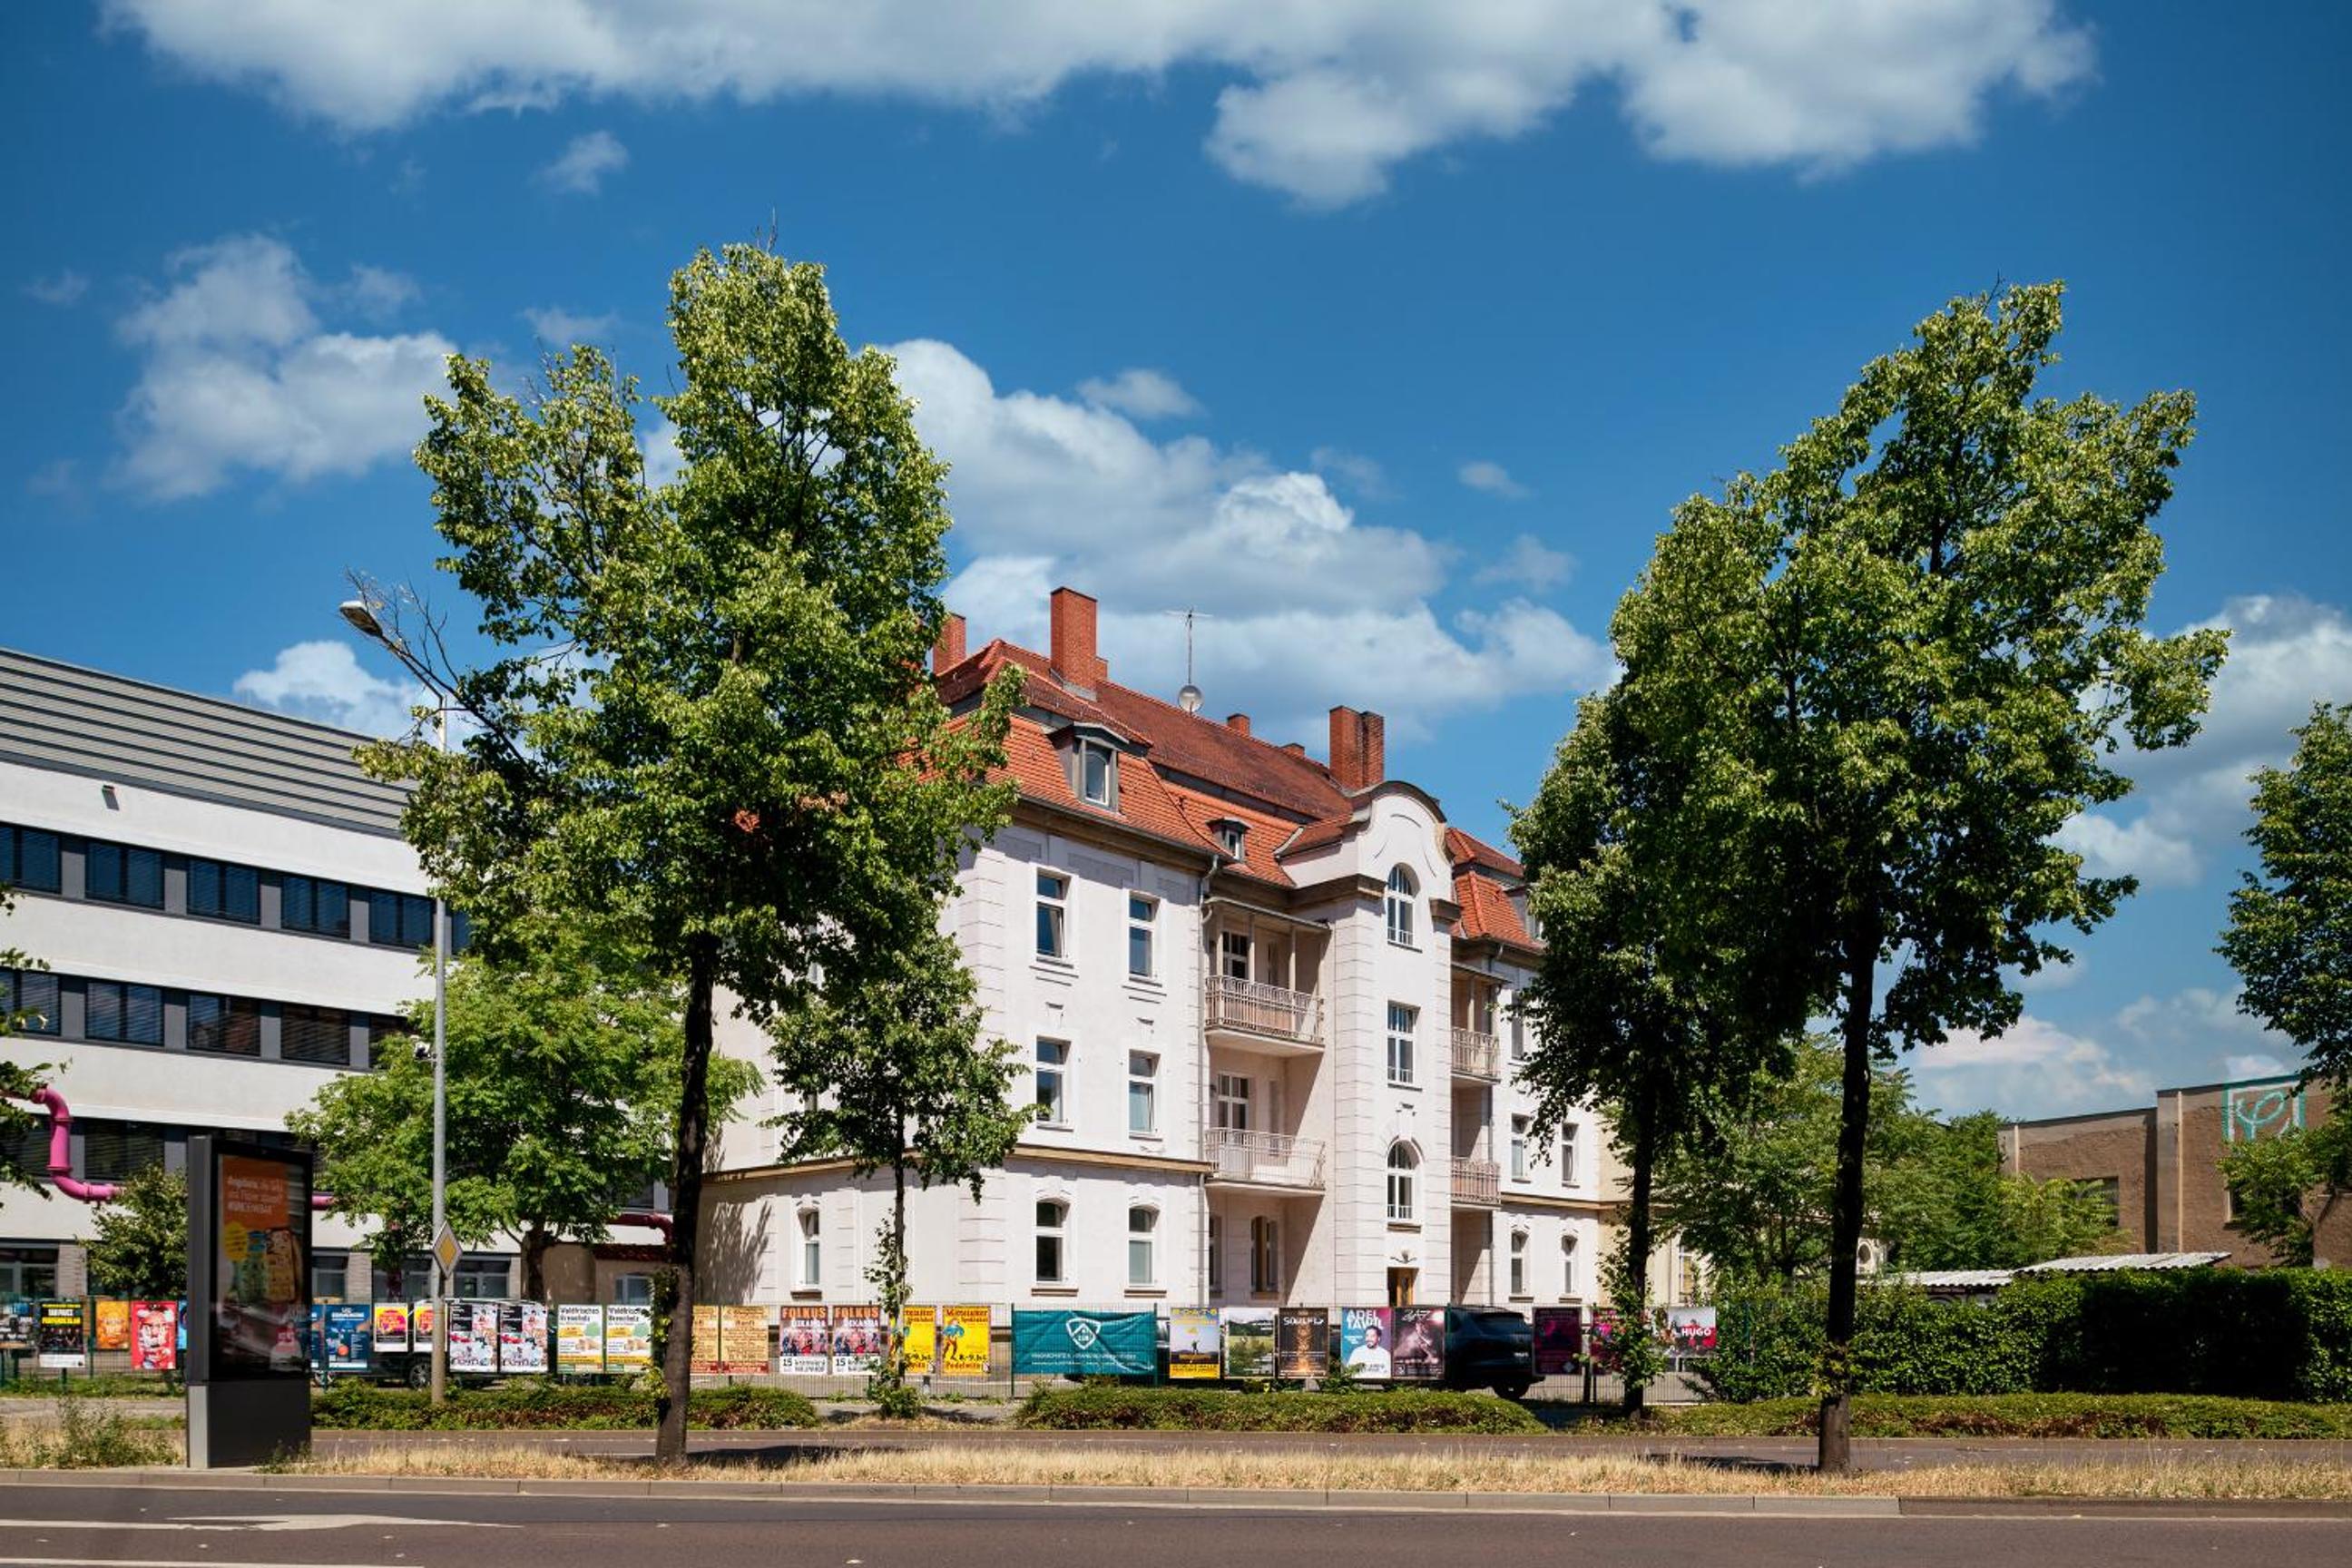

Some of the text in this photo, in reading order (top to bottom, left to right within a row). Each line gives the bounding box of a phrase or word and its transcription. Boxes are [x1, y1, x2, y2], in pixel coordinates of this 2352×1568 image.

[782, 1307, 826, 1318] FOLKUS
[835, 1307, 879, 1318] FOLKUS
[1347, 1309, 1379, 1319] ADEL
[1681, 1328, 1711, 1337] HUGO
[783, 1358, 793, 1367] 15
[836, 1358, 846, 1367] 15
